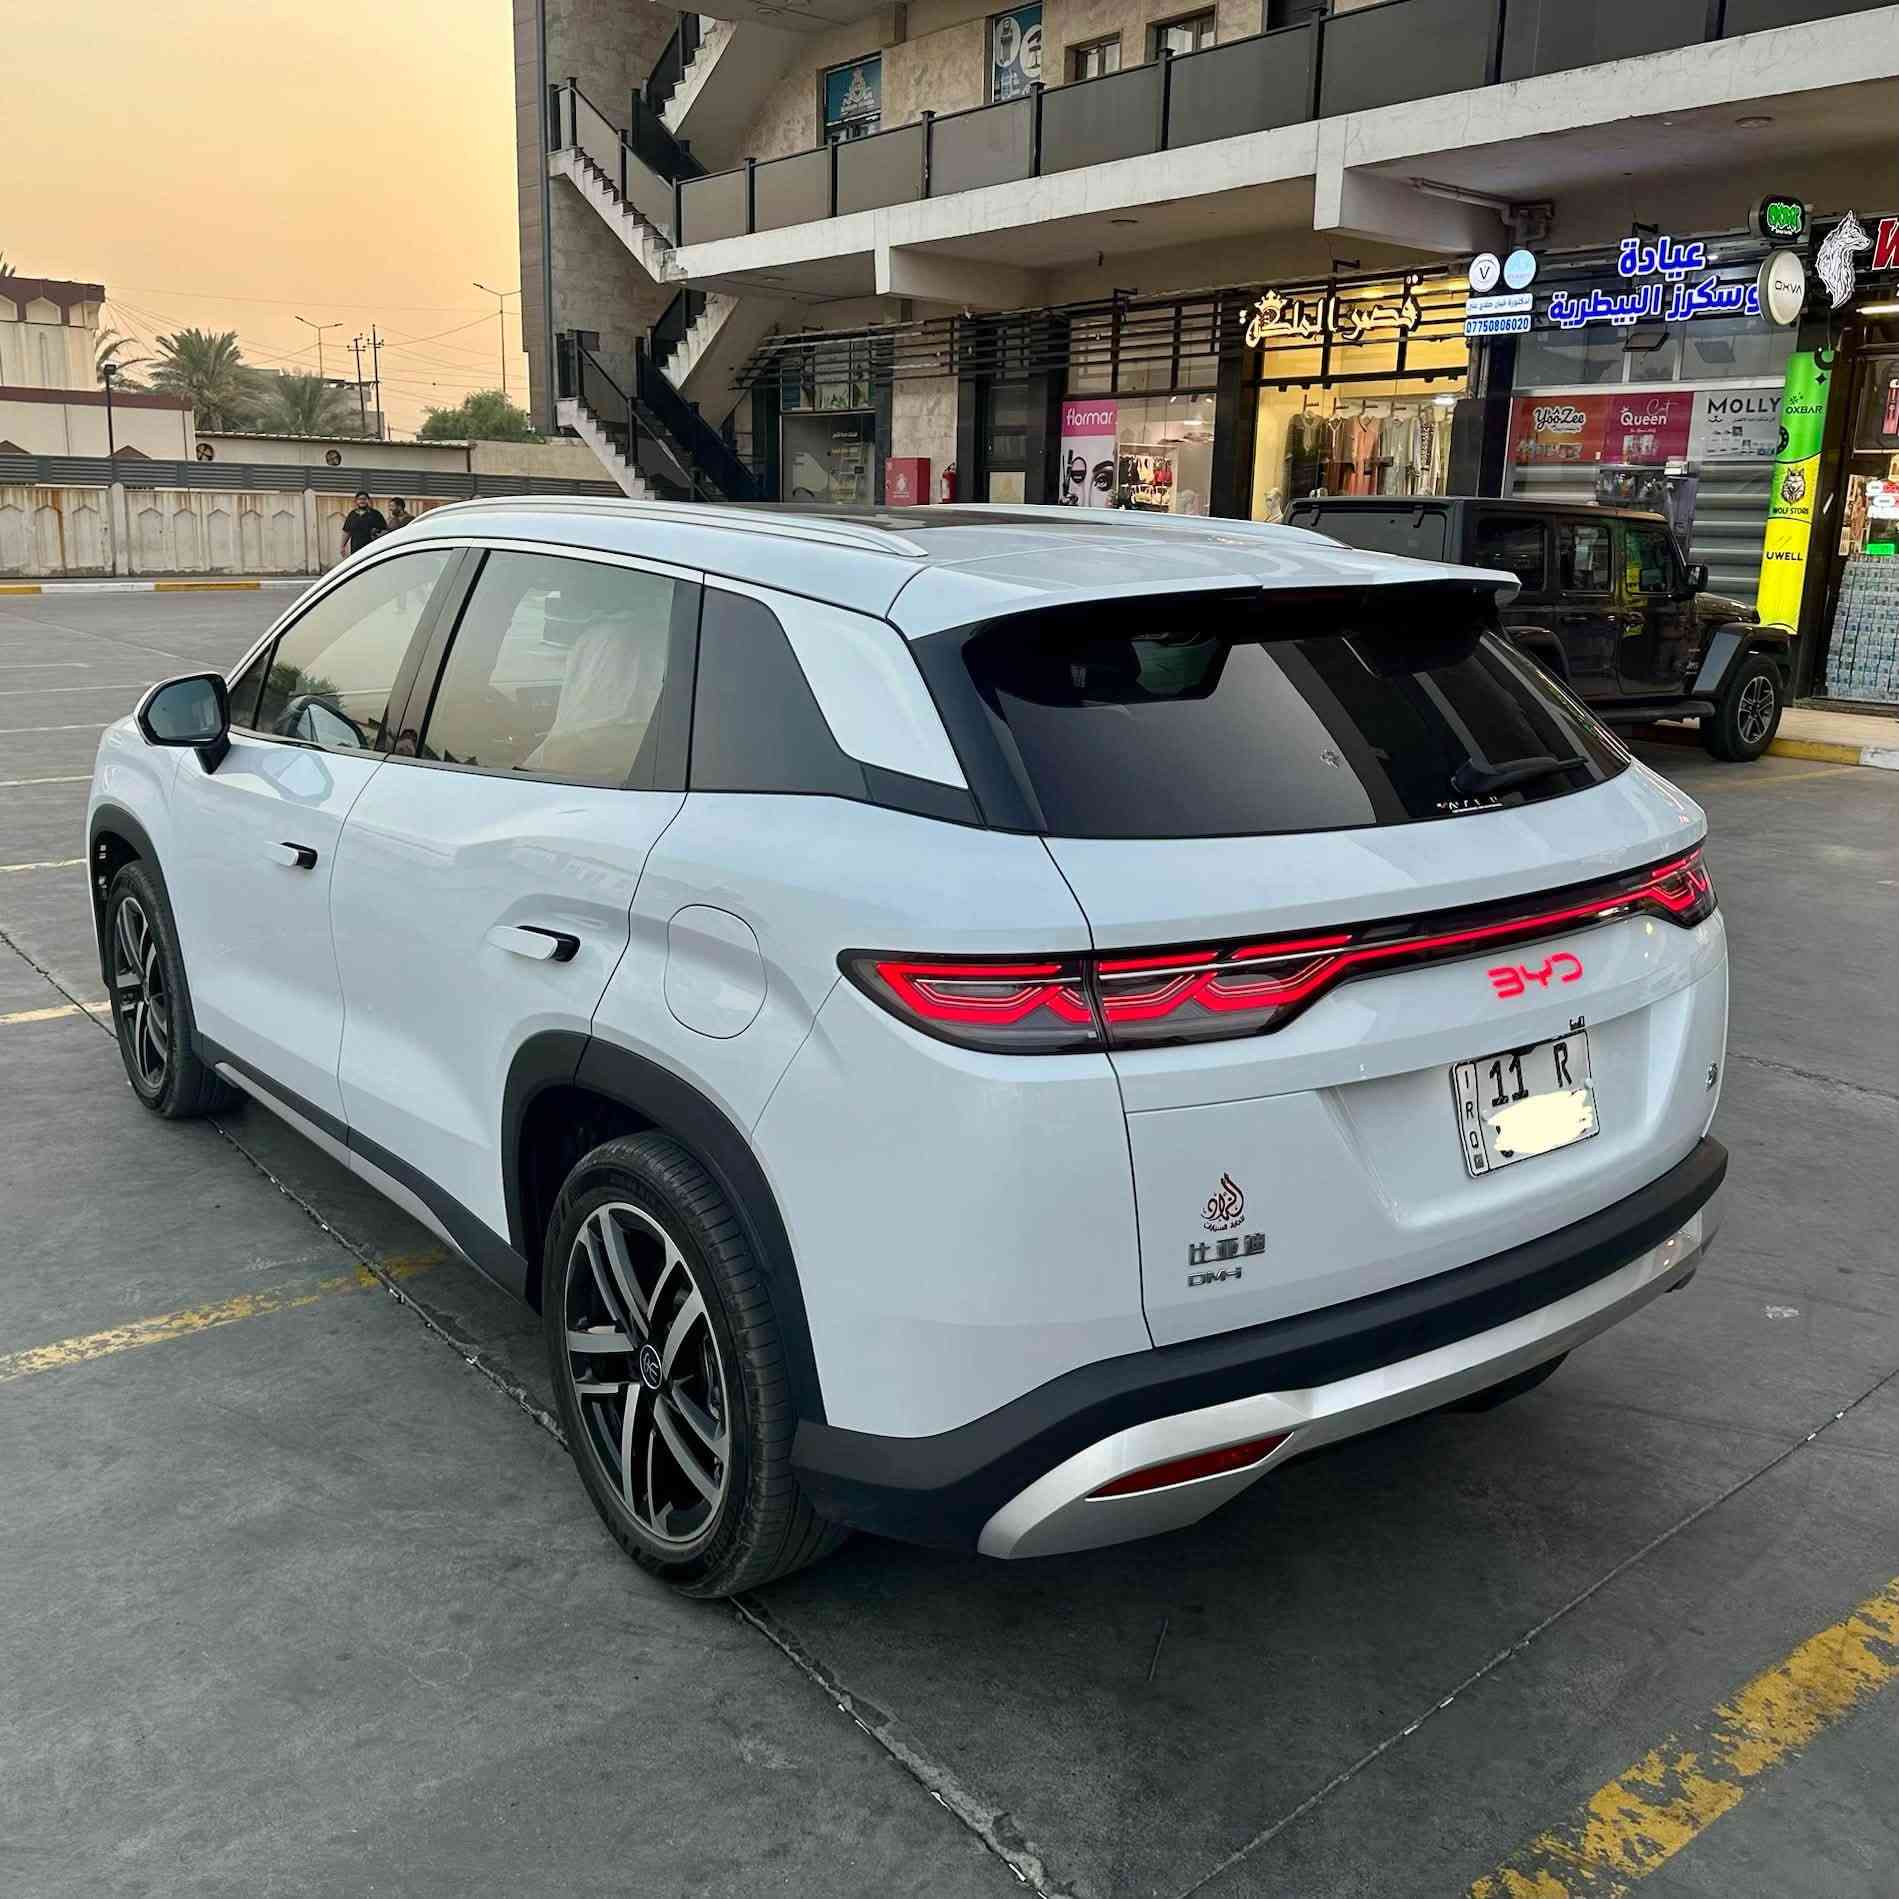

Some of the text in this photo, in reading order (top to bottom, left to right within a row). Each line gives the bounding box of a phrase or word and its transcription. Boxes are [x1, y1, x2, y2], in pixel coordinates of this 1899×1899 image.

[1618, 237, 1706, 281] عيادة
[1479, 266, 1490, 280] V
[1343, 274, 1421, 341] قصر
[1548, 284, 1663, 329] البيطرية
[1466, 317, 1529, 334] 07750806020
[1707, 397, 1781, 414] MOLLY
[1785, 405, 1823, 415] OXBAR
[1066, 408, 1113, 427] flormar
[1621, 409, 1667, 427] Queen
[1766, 551, 1804, 561] UWELL
[1488, 952, 1584, 999] BYD
[1489, 1042, 1573, 1107] 11 R
